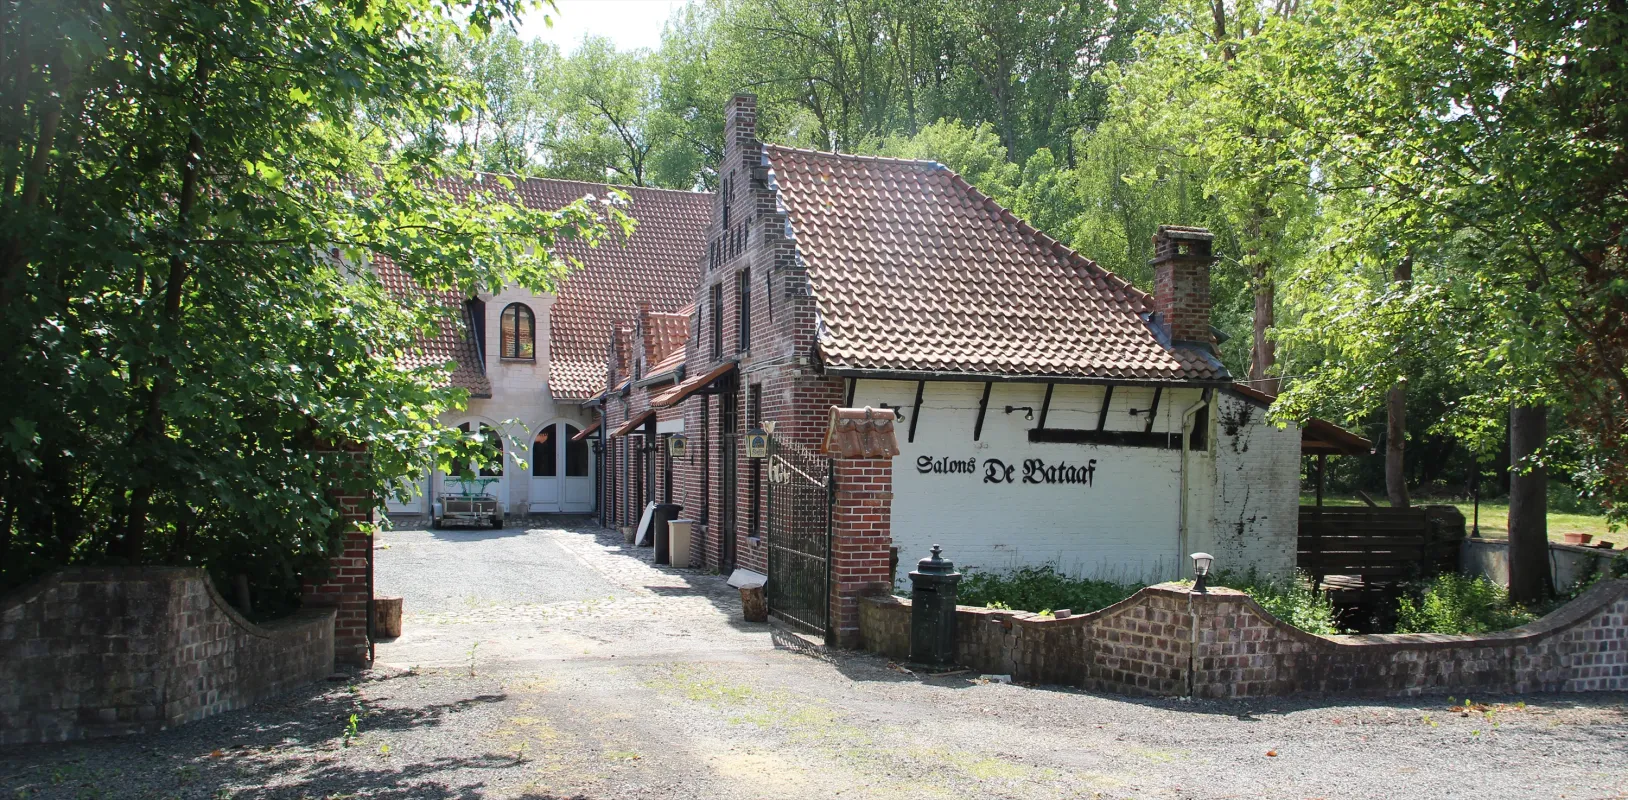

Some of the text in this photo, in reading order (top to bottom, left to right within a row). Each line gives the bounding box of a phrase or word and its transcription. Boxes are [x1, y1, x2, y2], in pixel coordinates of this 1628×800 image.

[917, 455, 1096, 487] Salons De Bataaf
